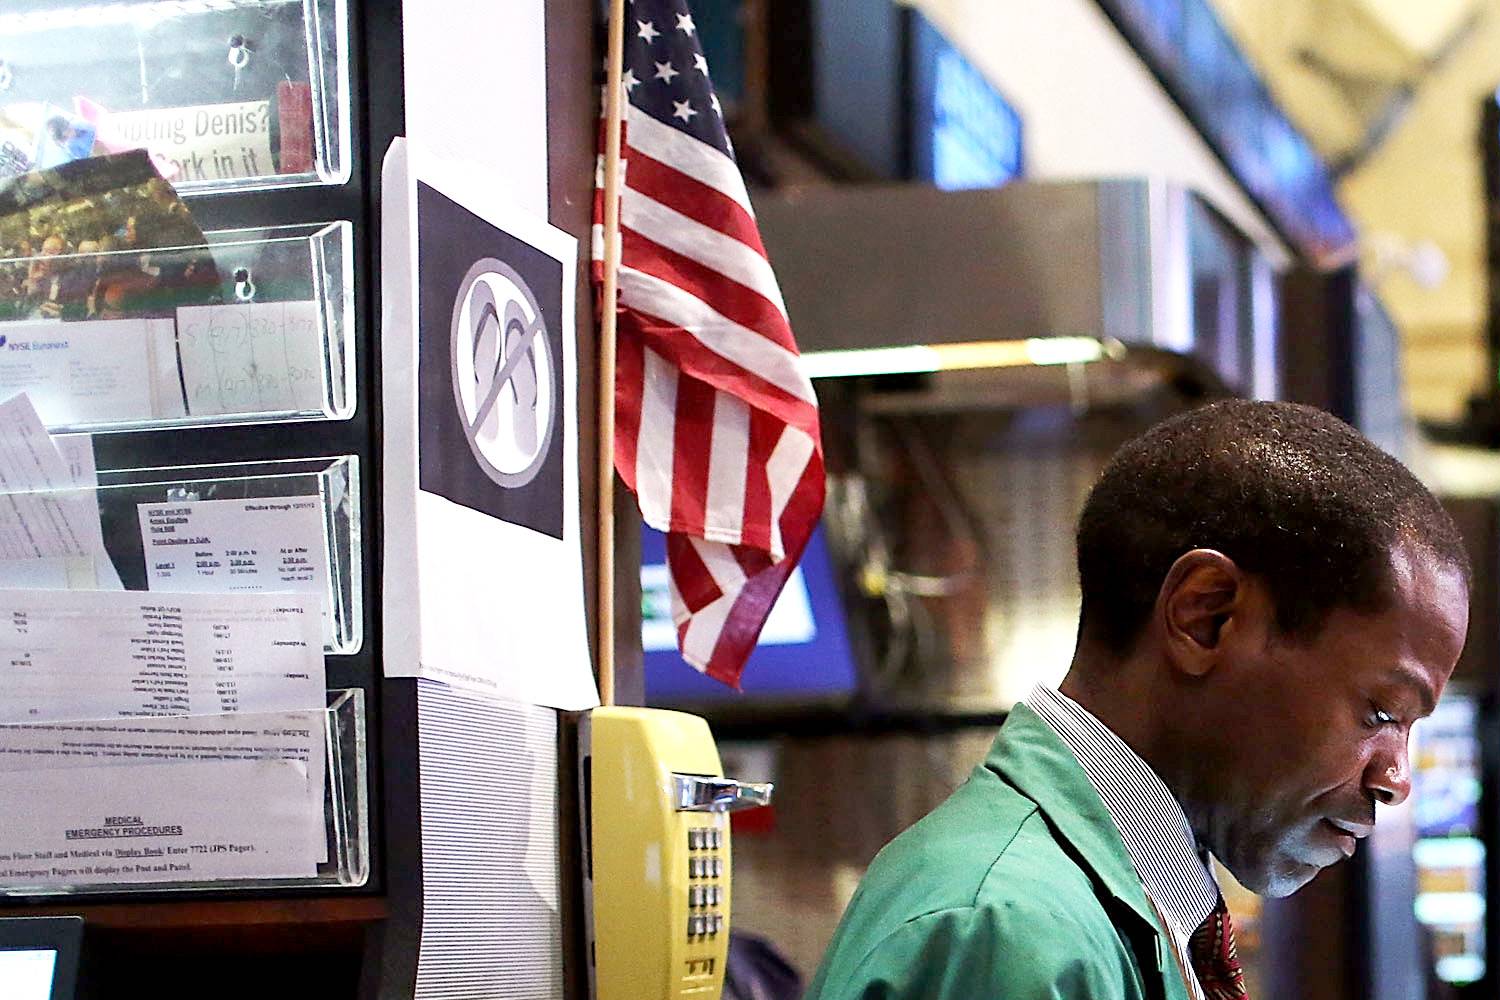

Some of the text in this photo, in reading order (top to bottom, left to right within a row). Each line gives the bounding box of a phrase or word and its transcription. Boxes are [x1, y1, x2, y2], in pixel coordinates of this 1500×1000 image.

[195, 105, 269, 136] Denis?
[212, 149, 235, 179] in
[240, 147, 259, 176] it
[8, 342, 31, 351] NYSE
[104, 816, 144, 827] MEDICAL
[65, 825, 183, 839] EMERGENCY PROCEDURES
[34, 851, 52, 859] Staff
[70, 849, 100, 858] Medical
[168, 846, 188, 854] Enter
[9, 870, 49, 879] Emergency
[52, 868, 77, 877] Pagers
[94, 865, 120, 876] display
[122, 865, 133, 873] the
[136, 864, 152, 872] Post
[153, 863, 167, 872] and
